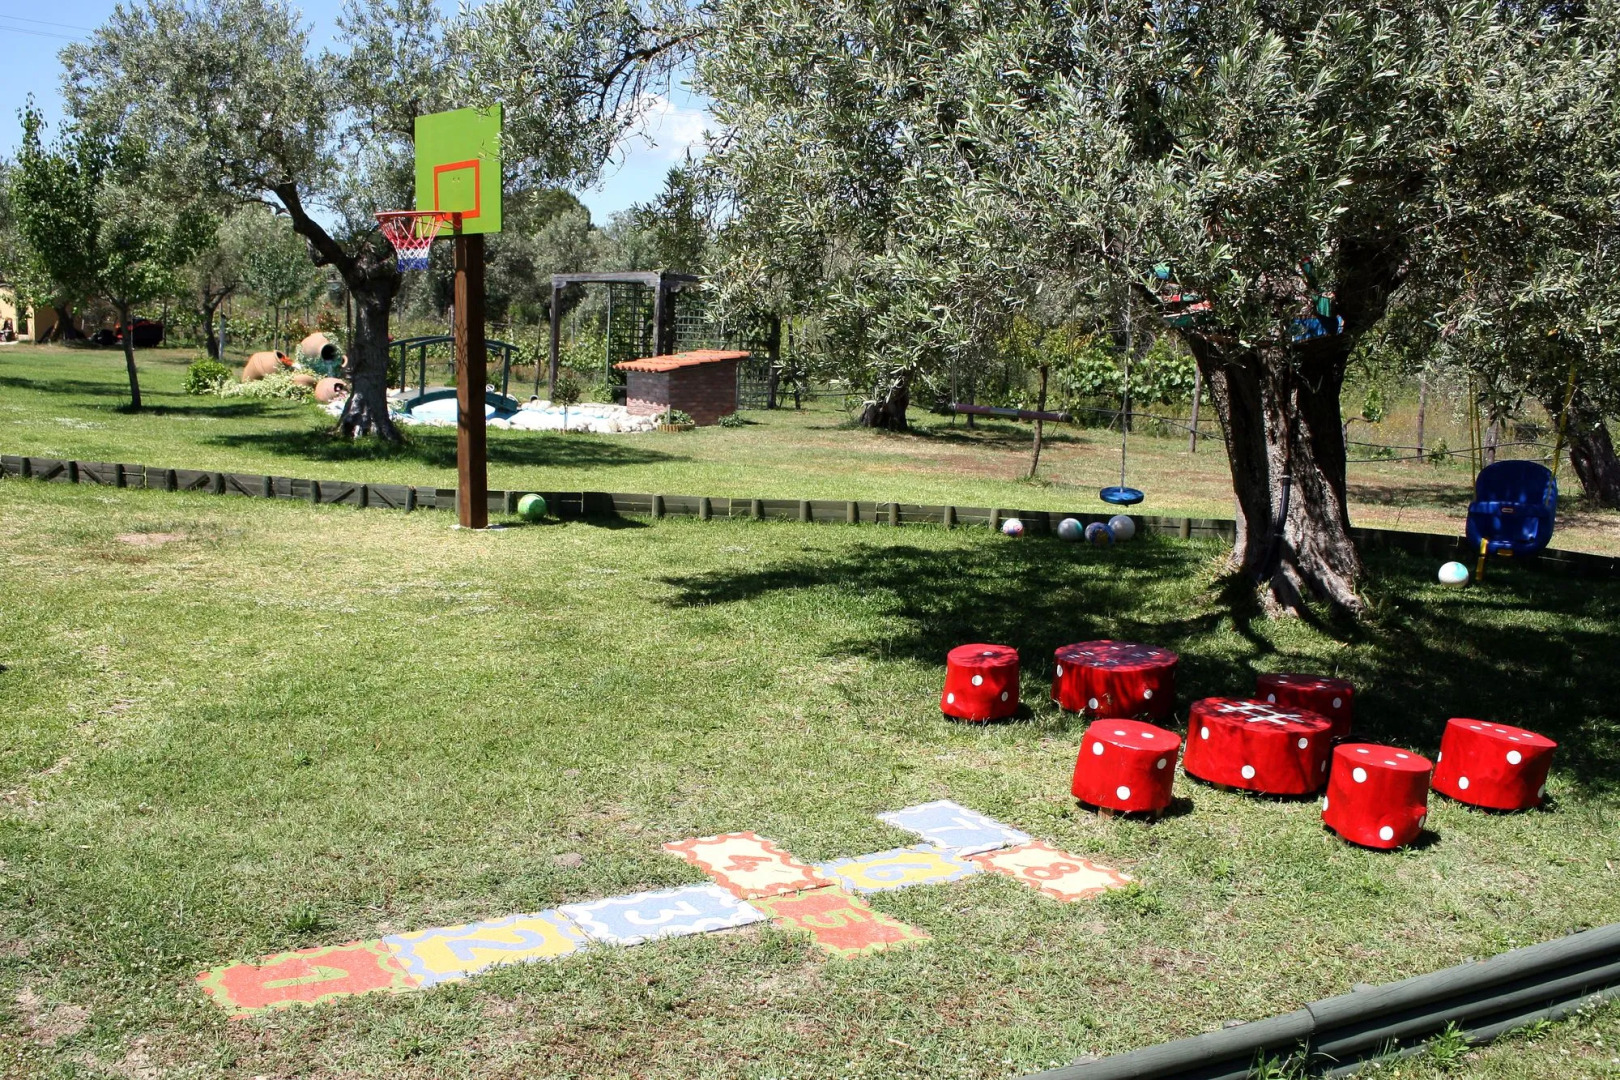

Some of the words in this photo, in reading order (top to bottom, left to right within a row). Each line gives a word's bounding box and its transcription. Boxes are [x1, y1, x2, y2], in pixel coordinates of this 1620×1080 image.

[723, 854, 772, 873] 4
[863, 863, 932, 881] 6
[1022, 861, 1081, 881] 8
[624, 902, 700, 925] 3
[803, 909, 866, 929] 5
[445, 930, 545, 961] 2
[264, 966, 348, 989] 1
